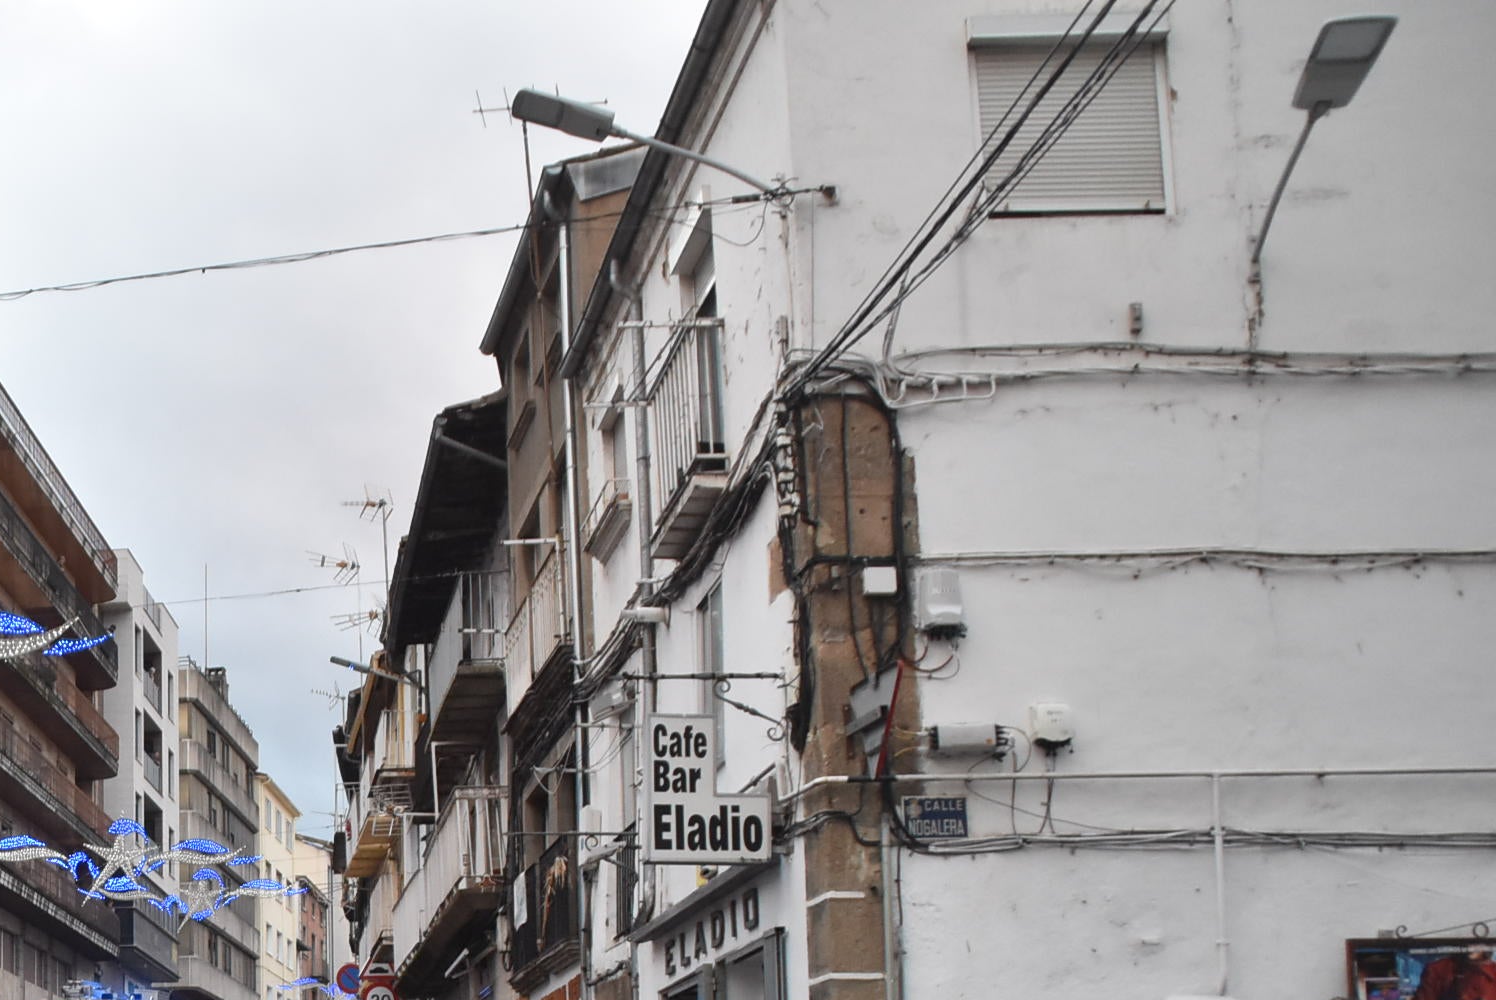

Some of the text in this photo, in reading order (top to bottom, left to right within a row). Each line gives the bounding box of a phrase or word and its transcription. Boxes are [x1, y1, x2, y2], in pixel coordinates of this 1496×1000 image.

[653, 723, 707, 758] Cafe
[653, 760, 701, 793] Bar
[925, 800, 964, 811] CALLE
[653, 804, 763, 852] Eladio
[908, 818, 965, 836] NOGALERA
[665, 887, 759, 977] ELADIO
